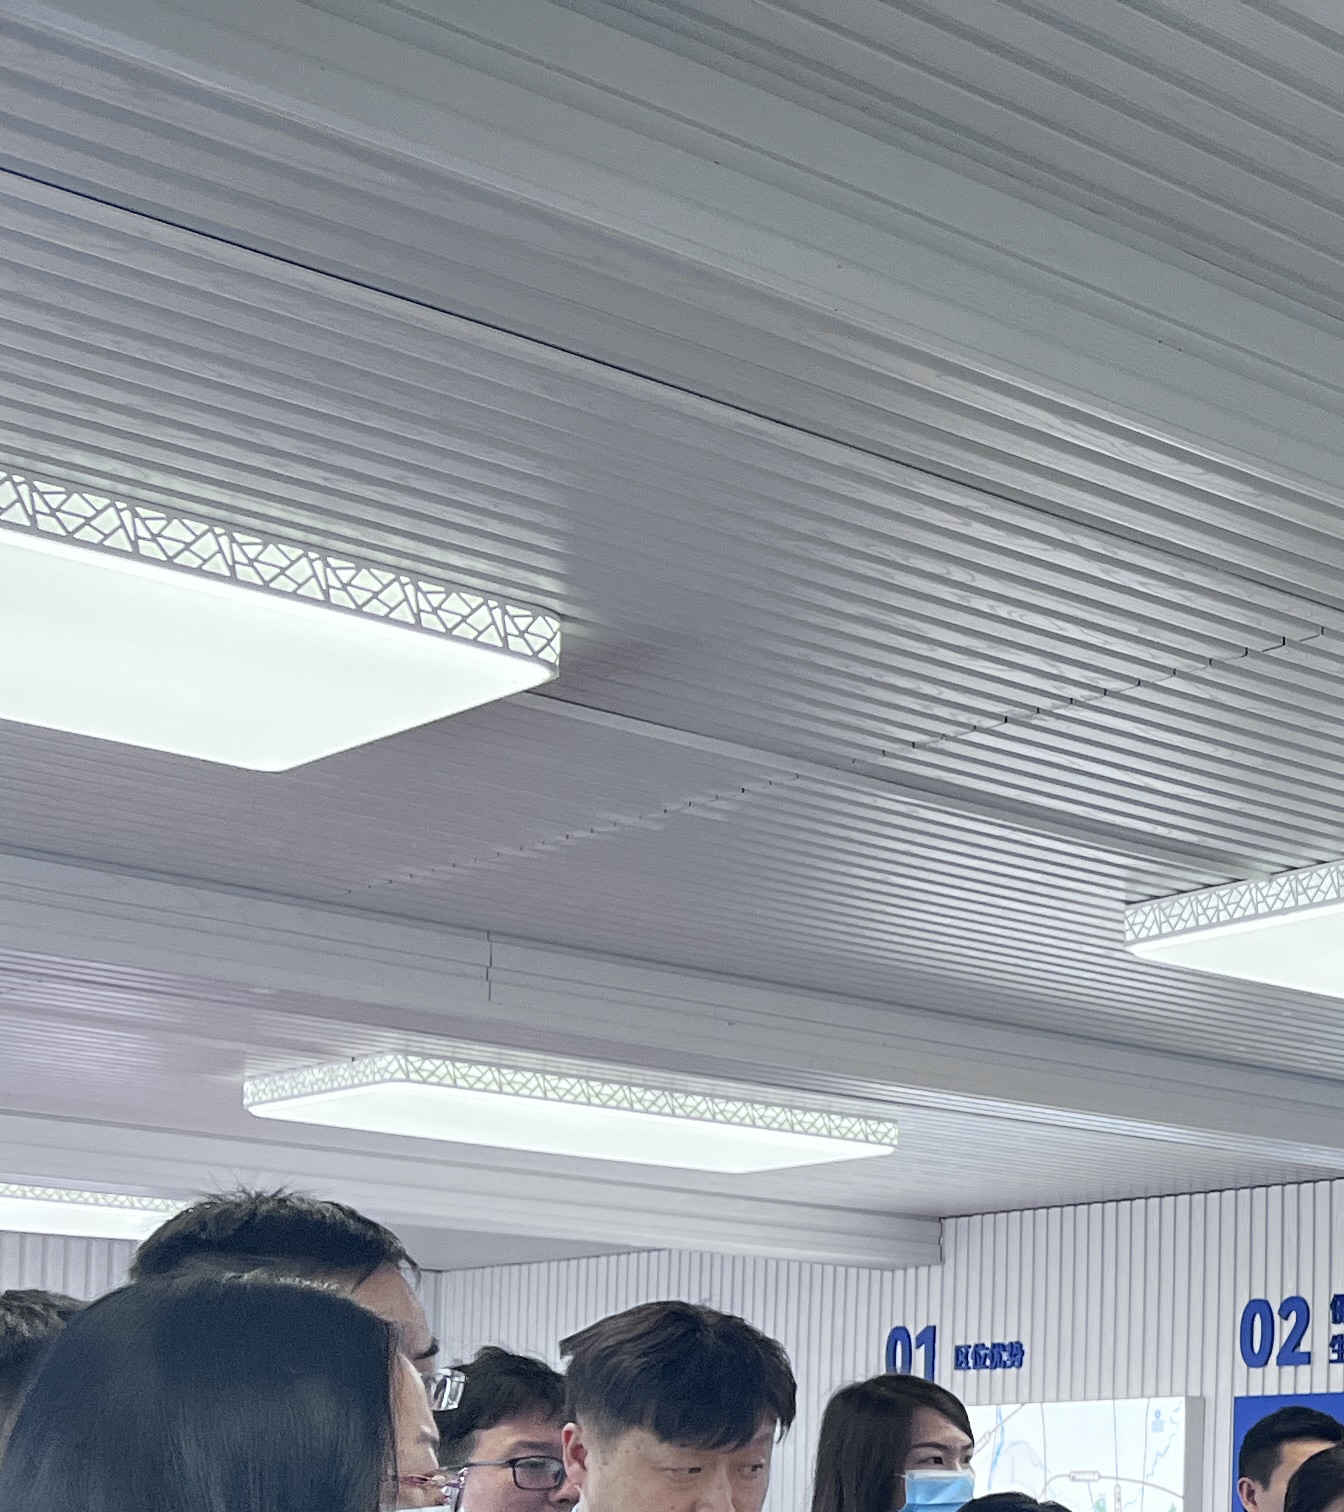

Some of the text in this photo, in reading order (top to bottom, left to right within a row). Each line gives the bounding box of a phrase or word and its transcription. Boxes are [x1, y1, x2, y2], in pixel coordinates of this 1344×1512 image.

[885, 1325, 937, 1384] 01
[954, 1340, 1025, 1371] 区位优势
[1239, 1295, 1312, 1368] 02
